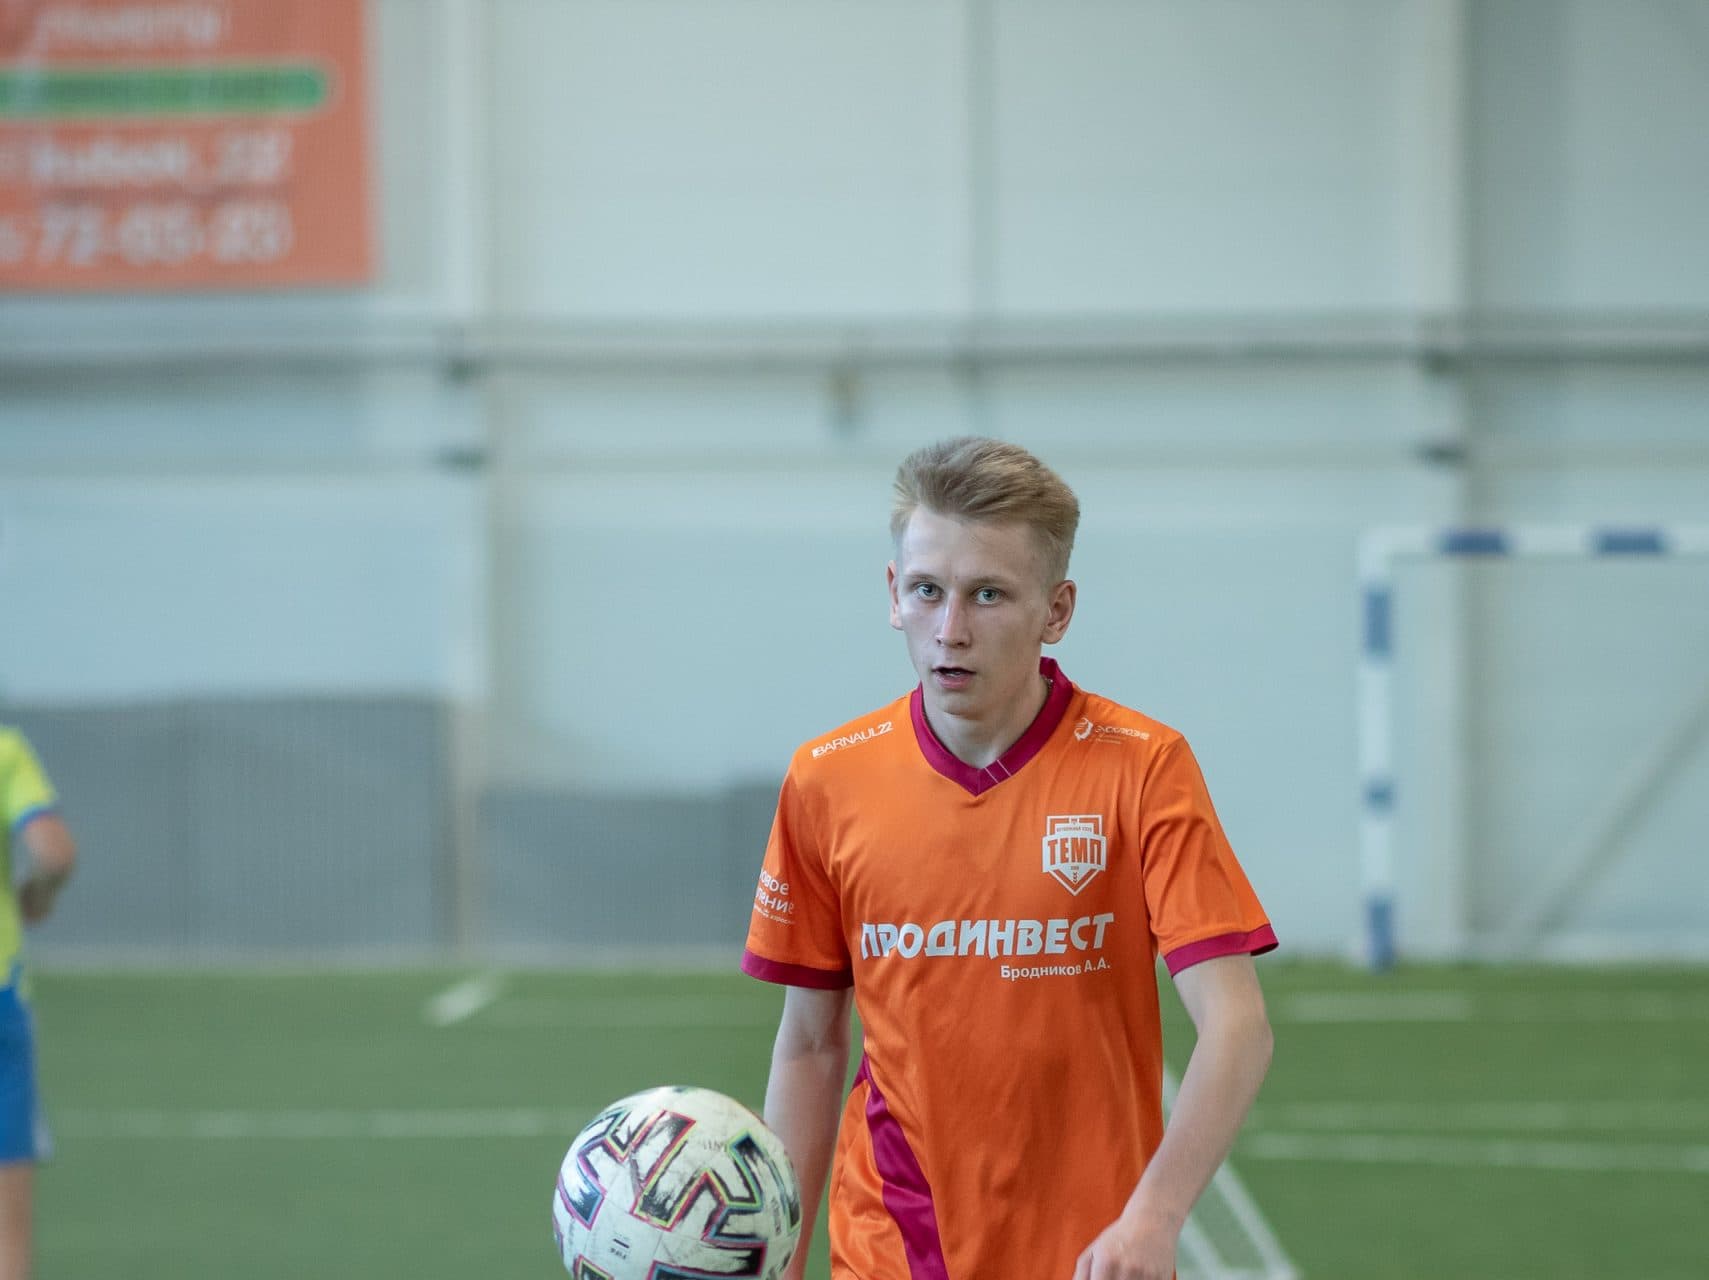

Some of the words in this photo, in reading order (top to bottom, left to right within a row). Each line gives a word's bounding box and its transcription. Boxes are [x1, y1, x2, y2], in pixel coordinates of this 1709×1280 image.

[1048, 837, 1101, 866] ТЕМП
[860, 912, 1115, 961] ПРОДИНВЕСТ
[1000, 964, 1082, 982] Бродников
[1083, 956, 1111, 973] А.А.
